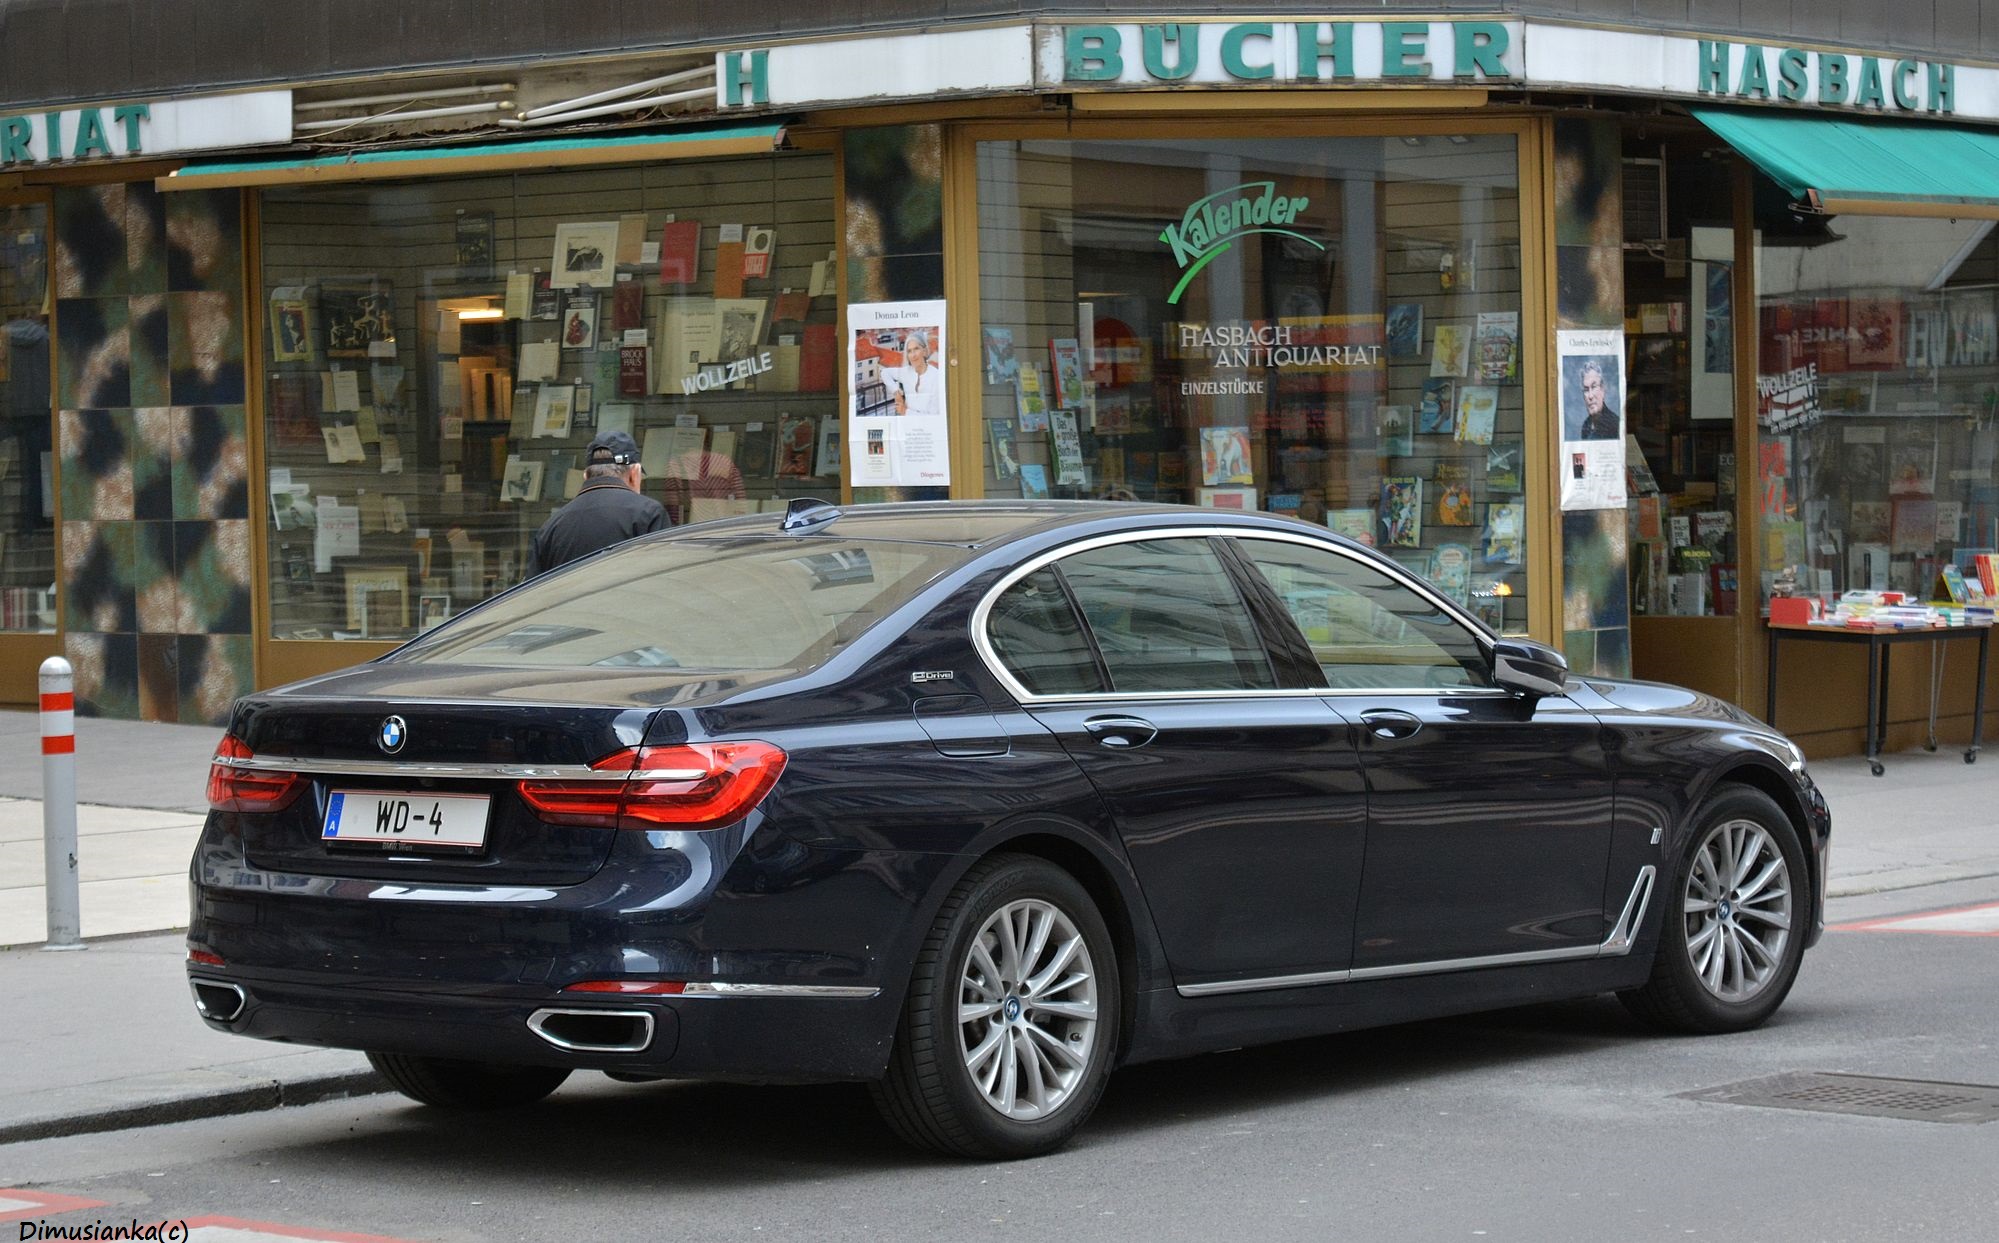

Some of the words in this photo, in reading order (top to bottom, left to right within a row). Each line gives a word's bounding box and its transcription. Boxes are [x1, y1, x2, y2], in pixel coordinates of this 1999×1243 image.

[1063, 22, 1510, 81] BÜCHER
[725, 50, 769, 106] H
[1698, 40, 1956, 113] HASBACH
[0, 104, 150, 163] RIAT
[1165, 181, 1309, 268] Kalender
[875, 312, 899, 320] Donna
[901, 310, 919, 319] Leon
[1180, 326, 1293, 347] HASBACH
[681, 352, 773, 396] WOLLZEILE
[1214, 346, 1382, 368] ANTIQUARIAT
[1181, 378, 1264, 395] EINZELSTÜCKE
[1758, 362, 1817, 399] WOLLZEILE
[329, 820, 335, 831] A
[375, 800, 443, 835] WD-4
